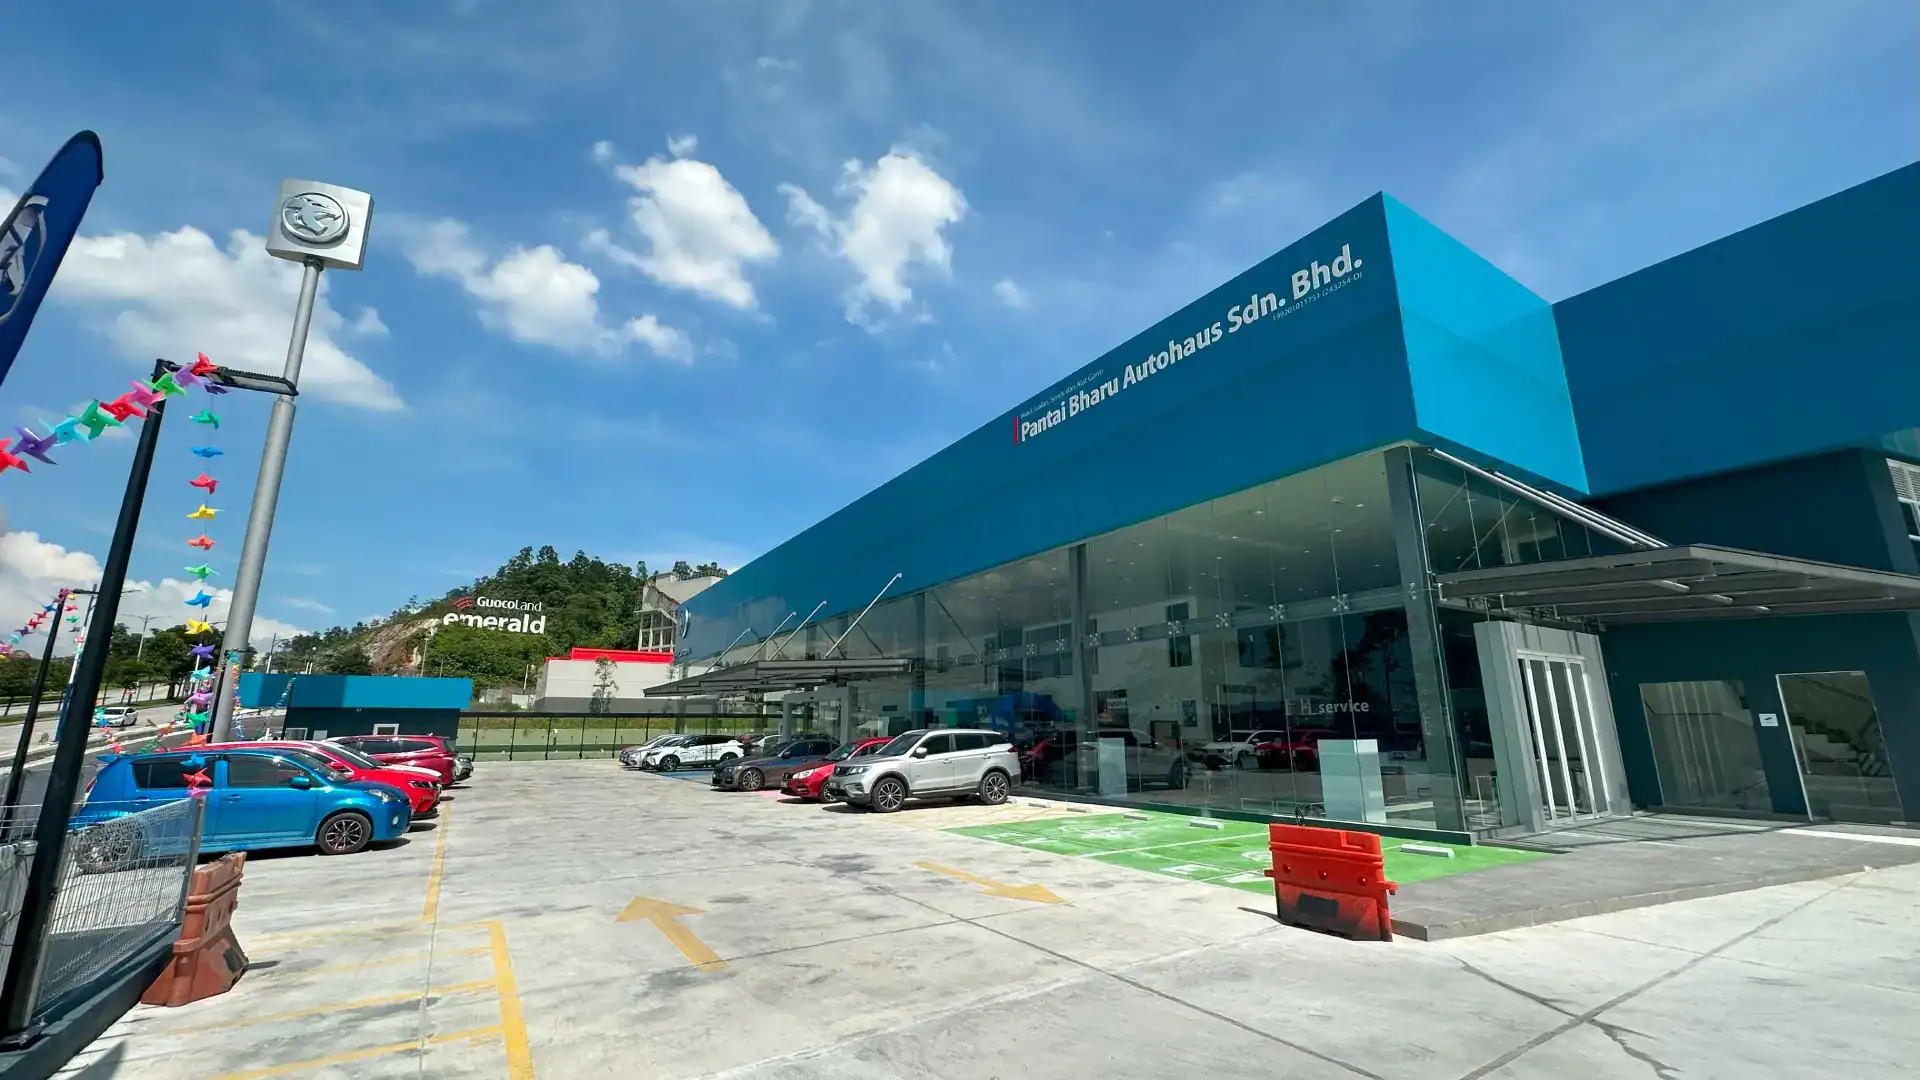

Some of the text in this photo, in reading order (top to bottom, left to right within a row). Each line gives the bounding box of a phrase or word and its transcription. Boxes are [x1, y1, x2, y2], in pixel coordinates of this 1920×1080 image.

[1021, 243, 1363, 442] Pantai Bharu Autohaus Sdn. Bhd.
[443, 612, 546, 634] emerald
[1318, 700, 1370, 714] service
